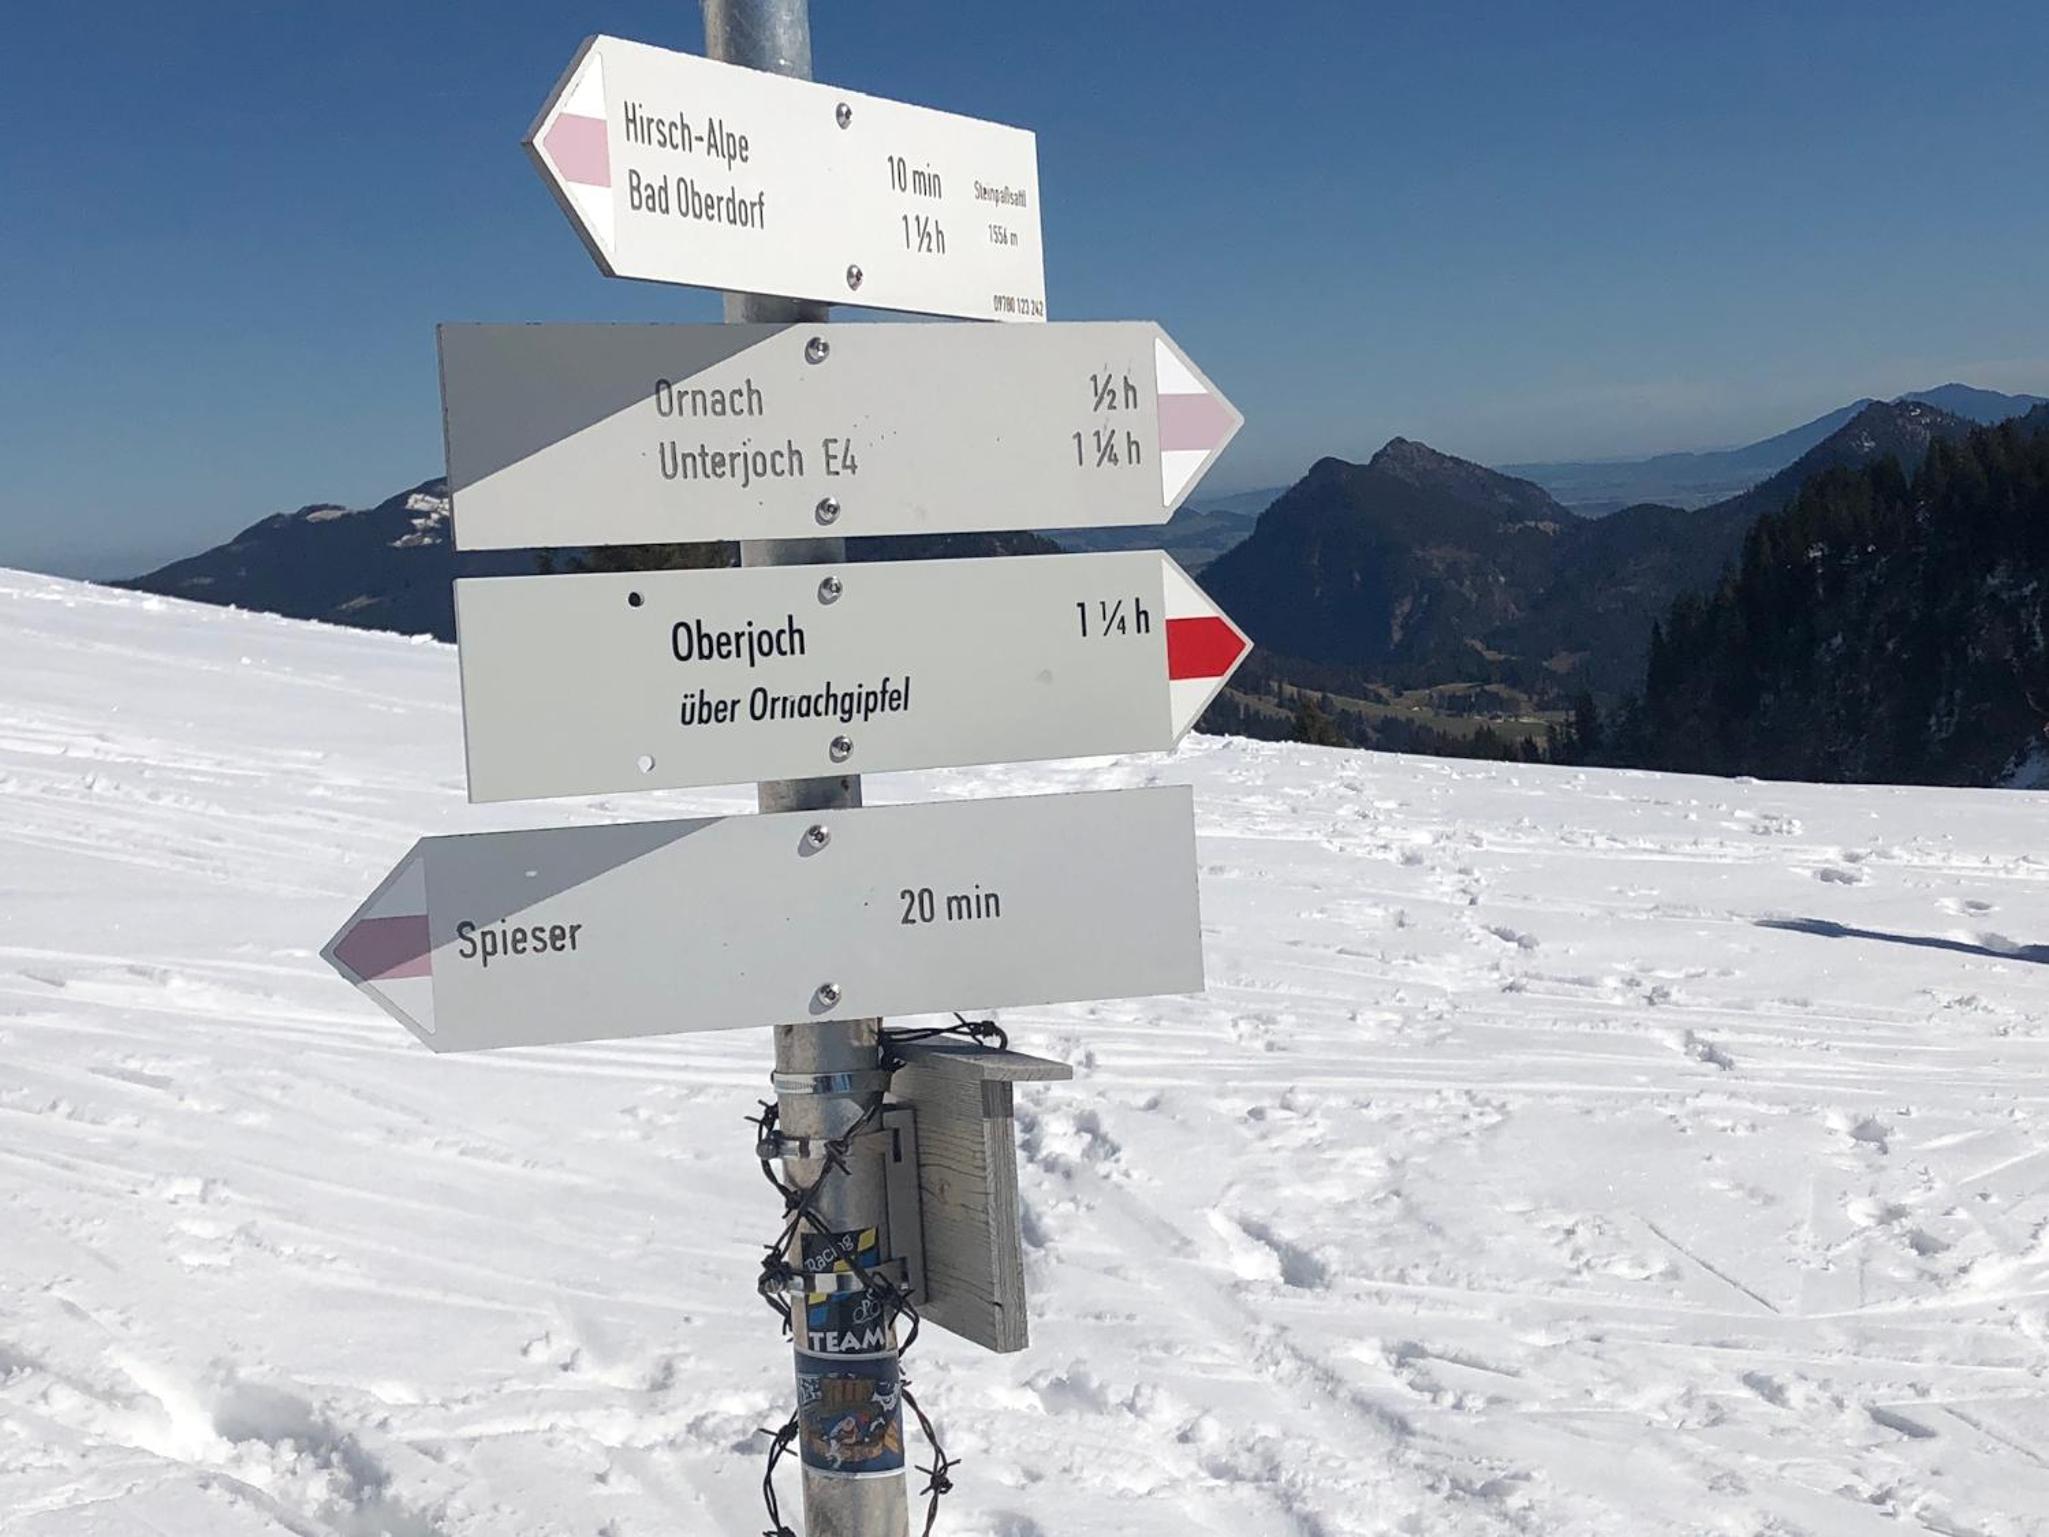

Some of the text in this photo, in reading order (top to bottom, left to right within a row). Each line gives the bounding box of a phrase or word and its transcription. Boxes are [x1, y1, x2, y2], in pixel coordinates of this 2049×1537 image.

[623, 100, 749, 171] Hirsch-Alpe
[628, 168, 765, 230] Bad Oberdorf
[887, 155, 942, 200] 10 min
[988, 223, 1019, 247] 1556 m
[655, 377, 763, 418] Ornach
[1123, 375, 1138, 410] h
[659, 437, 859, 489] Unterjoch E4
[1126, 430, 1141, 465] h
[1134, 597, 1150, 635] h
[671, 614, 806, 668] Oberjoch
[680, 676, 910, 726] über Ornachgipfel
[900, 884, 1001, 925] 20 min
[457, 919, 583, 968] Spieser
[808, 1326, 885, 1352] TEAM
